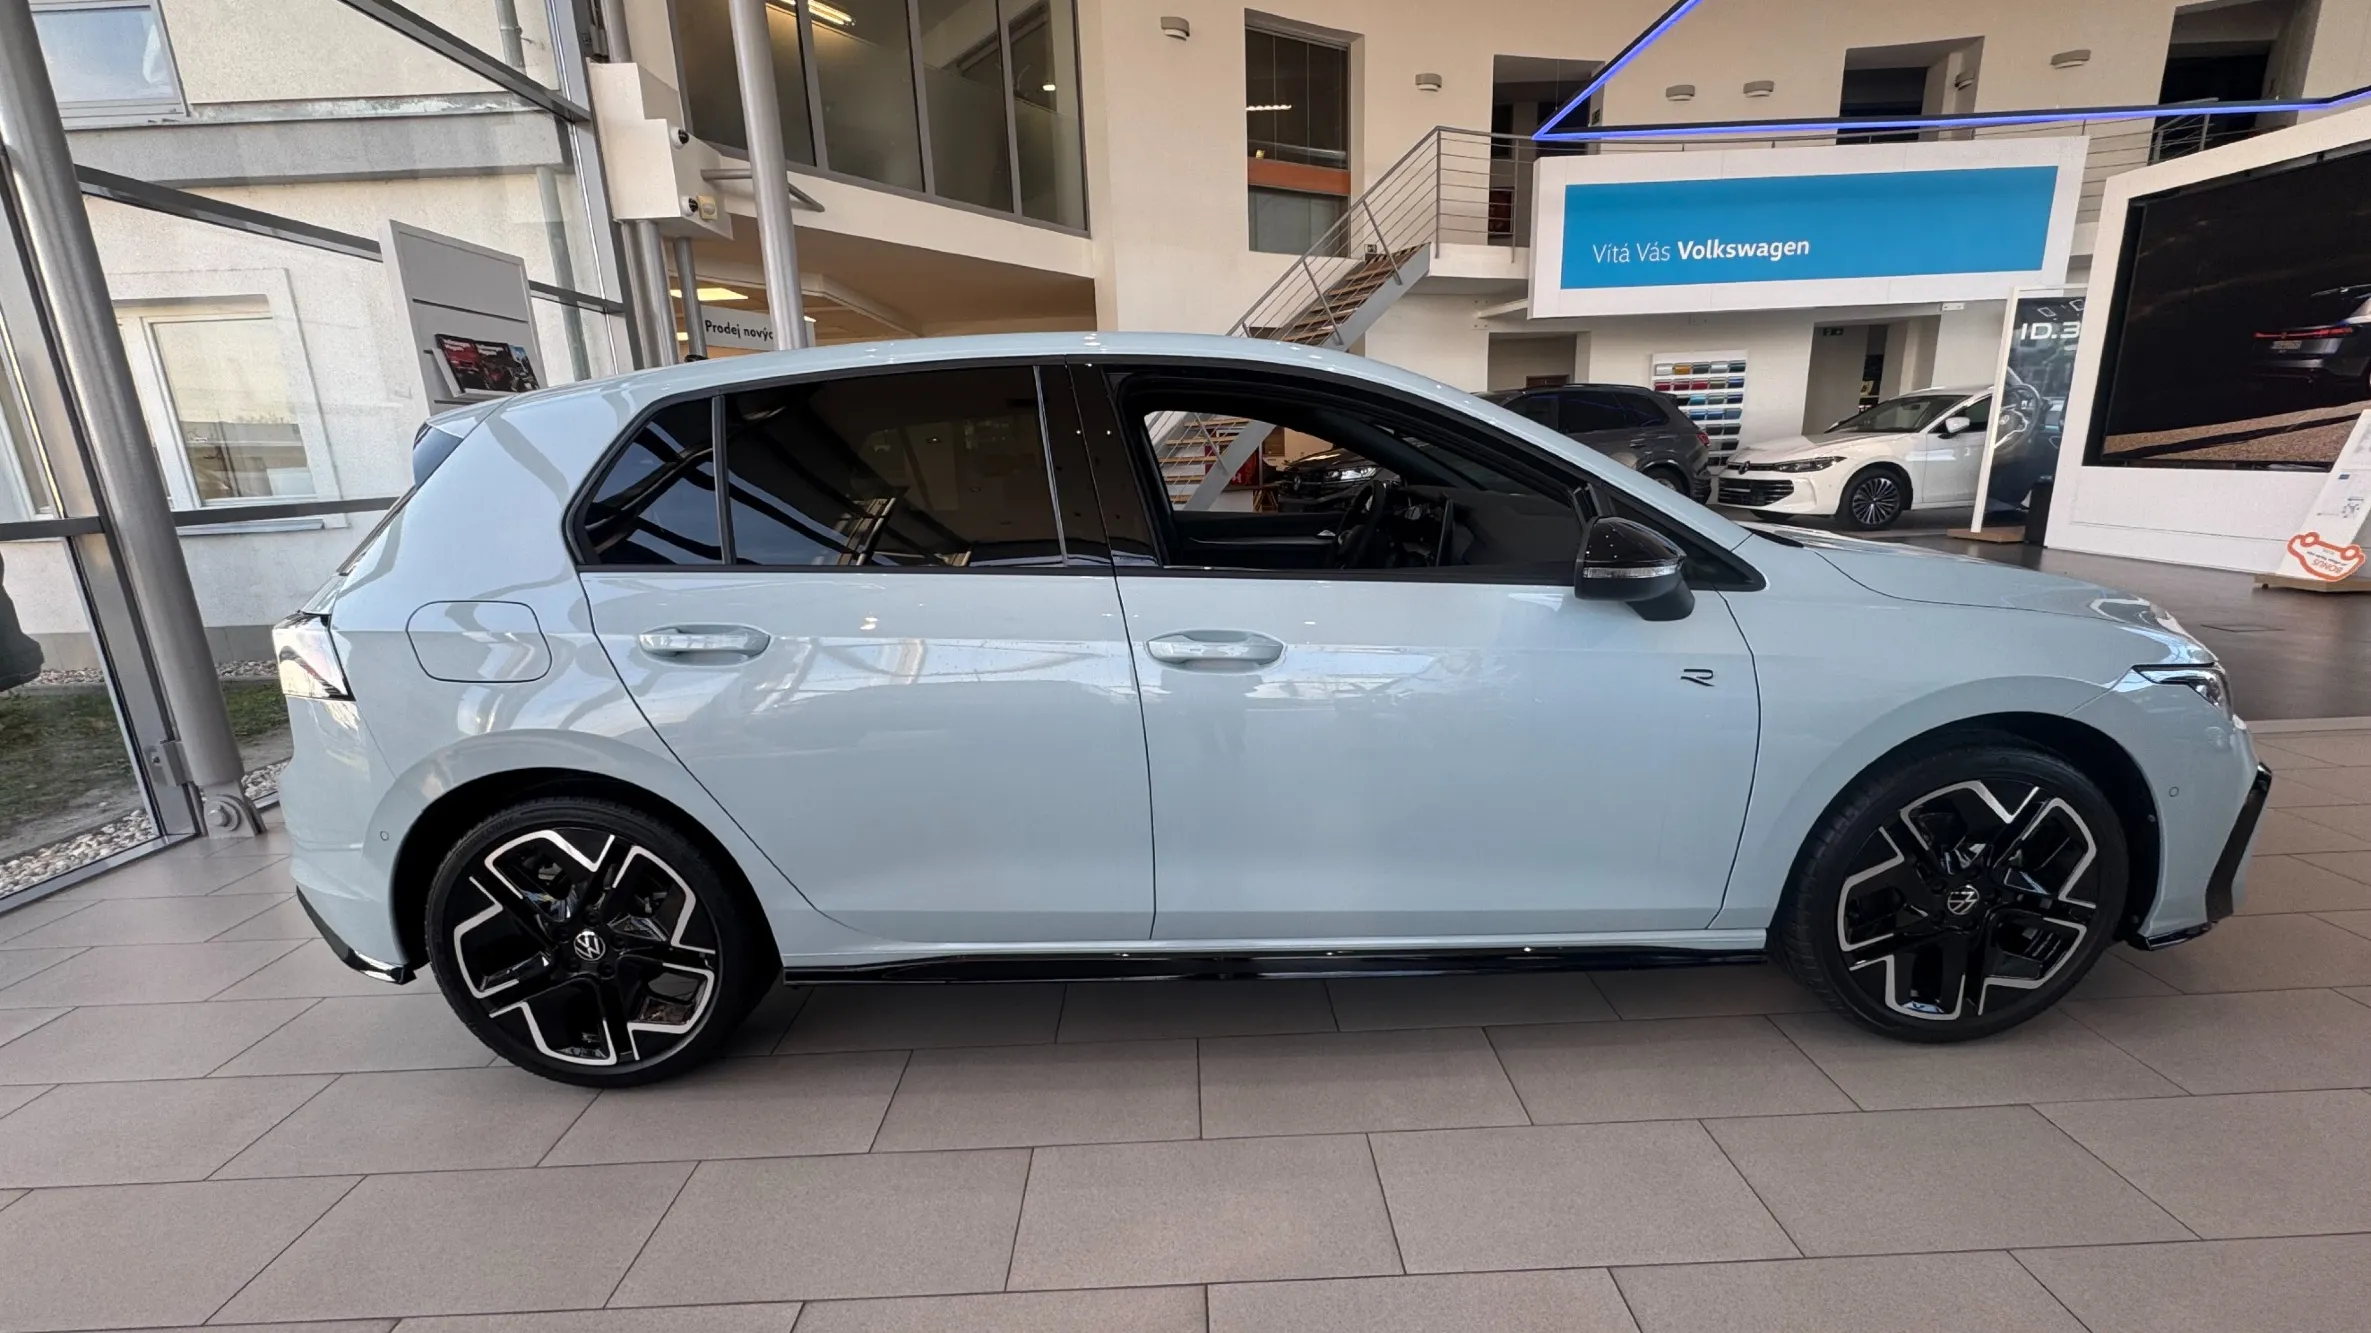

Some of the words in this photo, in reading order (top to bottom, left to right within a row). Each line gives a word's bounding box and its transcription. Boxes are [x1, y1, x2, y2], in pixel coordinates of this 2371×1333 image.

[1593, 243, 1630, 263] Vítá
[1636, 241, 1671, 261] Vás
[1677, 239, 1809, 261] Volkswagen
[705, 320, 741, 338] Prodej
[2021, 322, 2081, 340] ID.3
